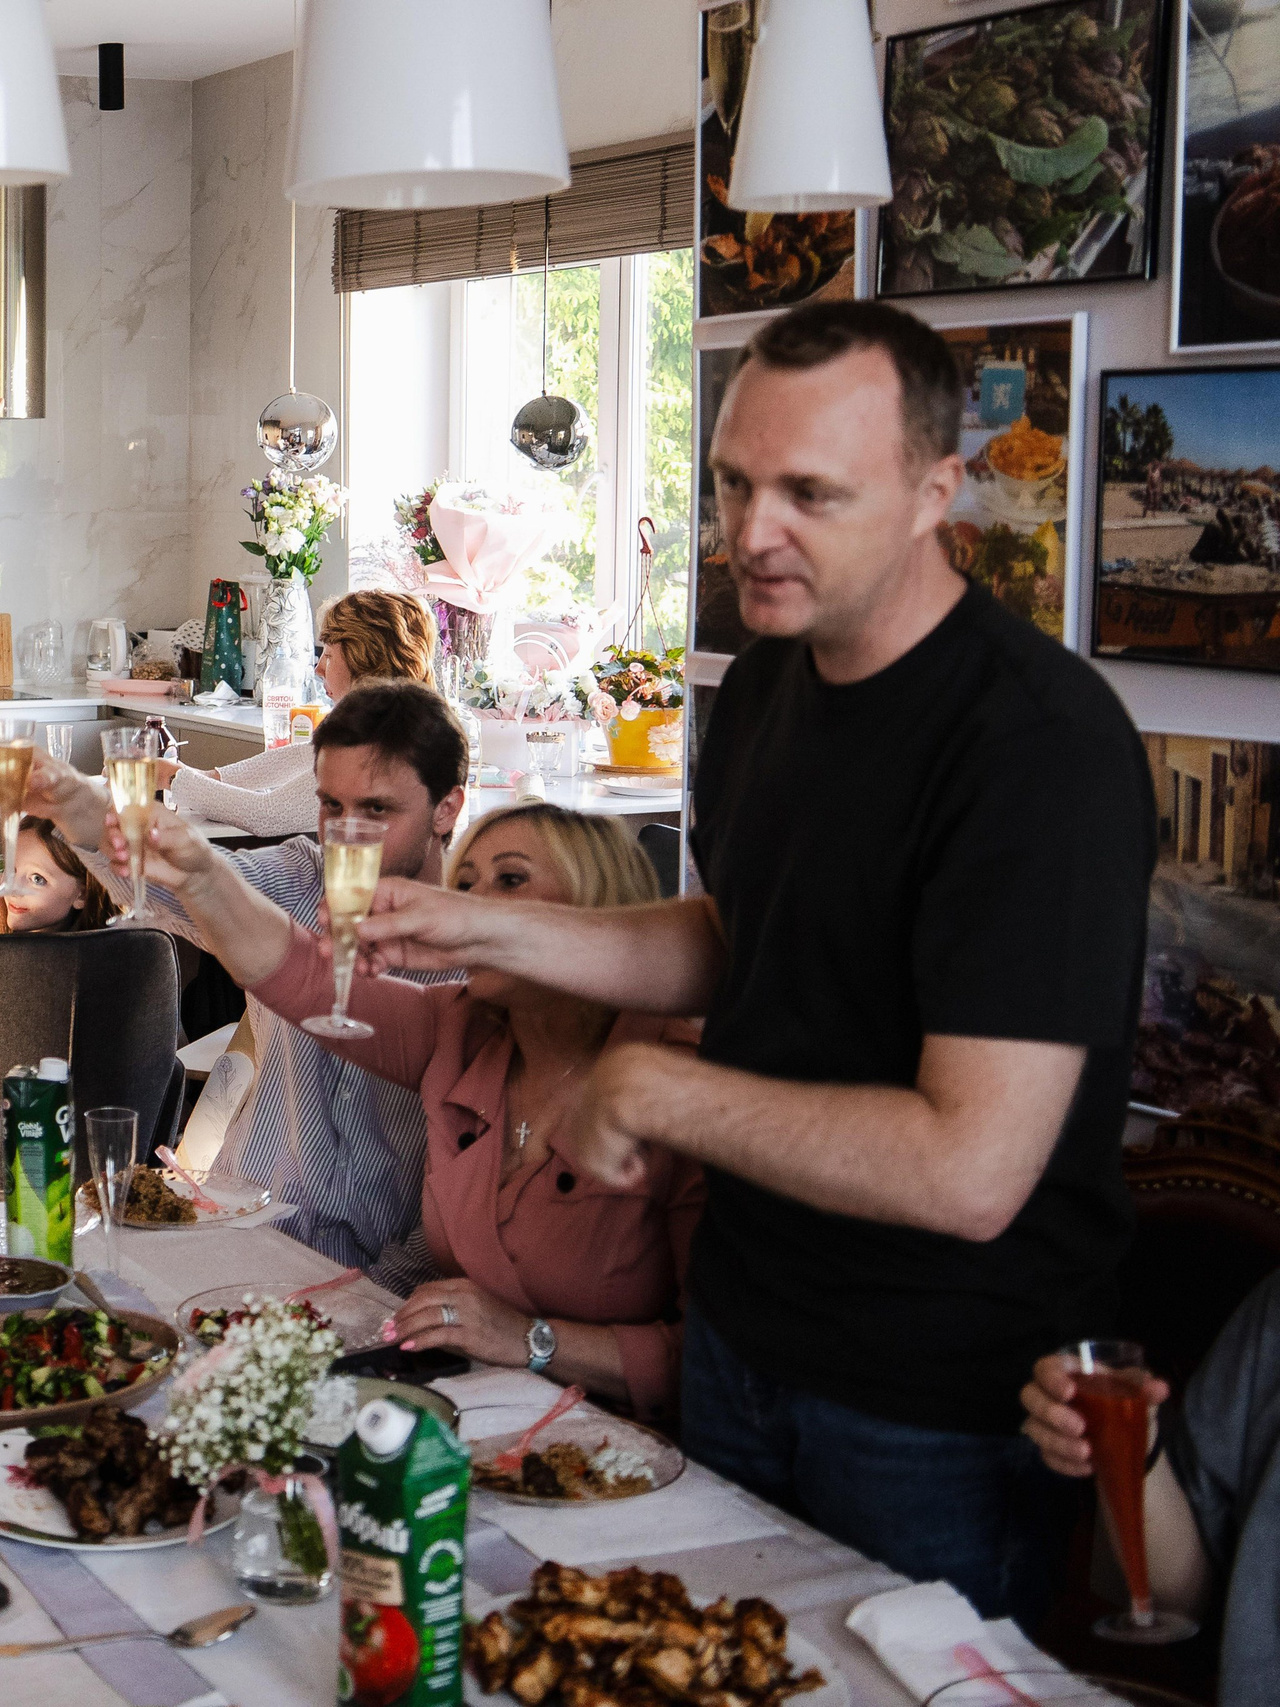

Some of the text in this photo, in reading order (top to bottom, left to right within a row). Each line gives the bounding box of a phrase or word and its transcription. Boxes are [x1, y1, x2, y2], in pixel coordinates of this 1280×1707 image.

[18, 1121, 40, 1131] Global
[20, 1128, 43, 1138] Village
[339, 1502, 410, 1554] обрый
